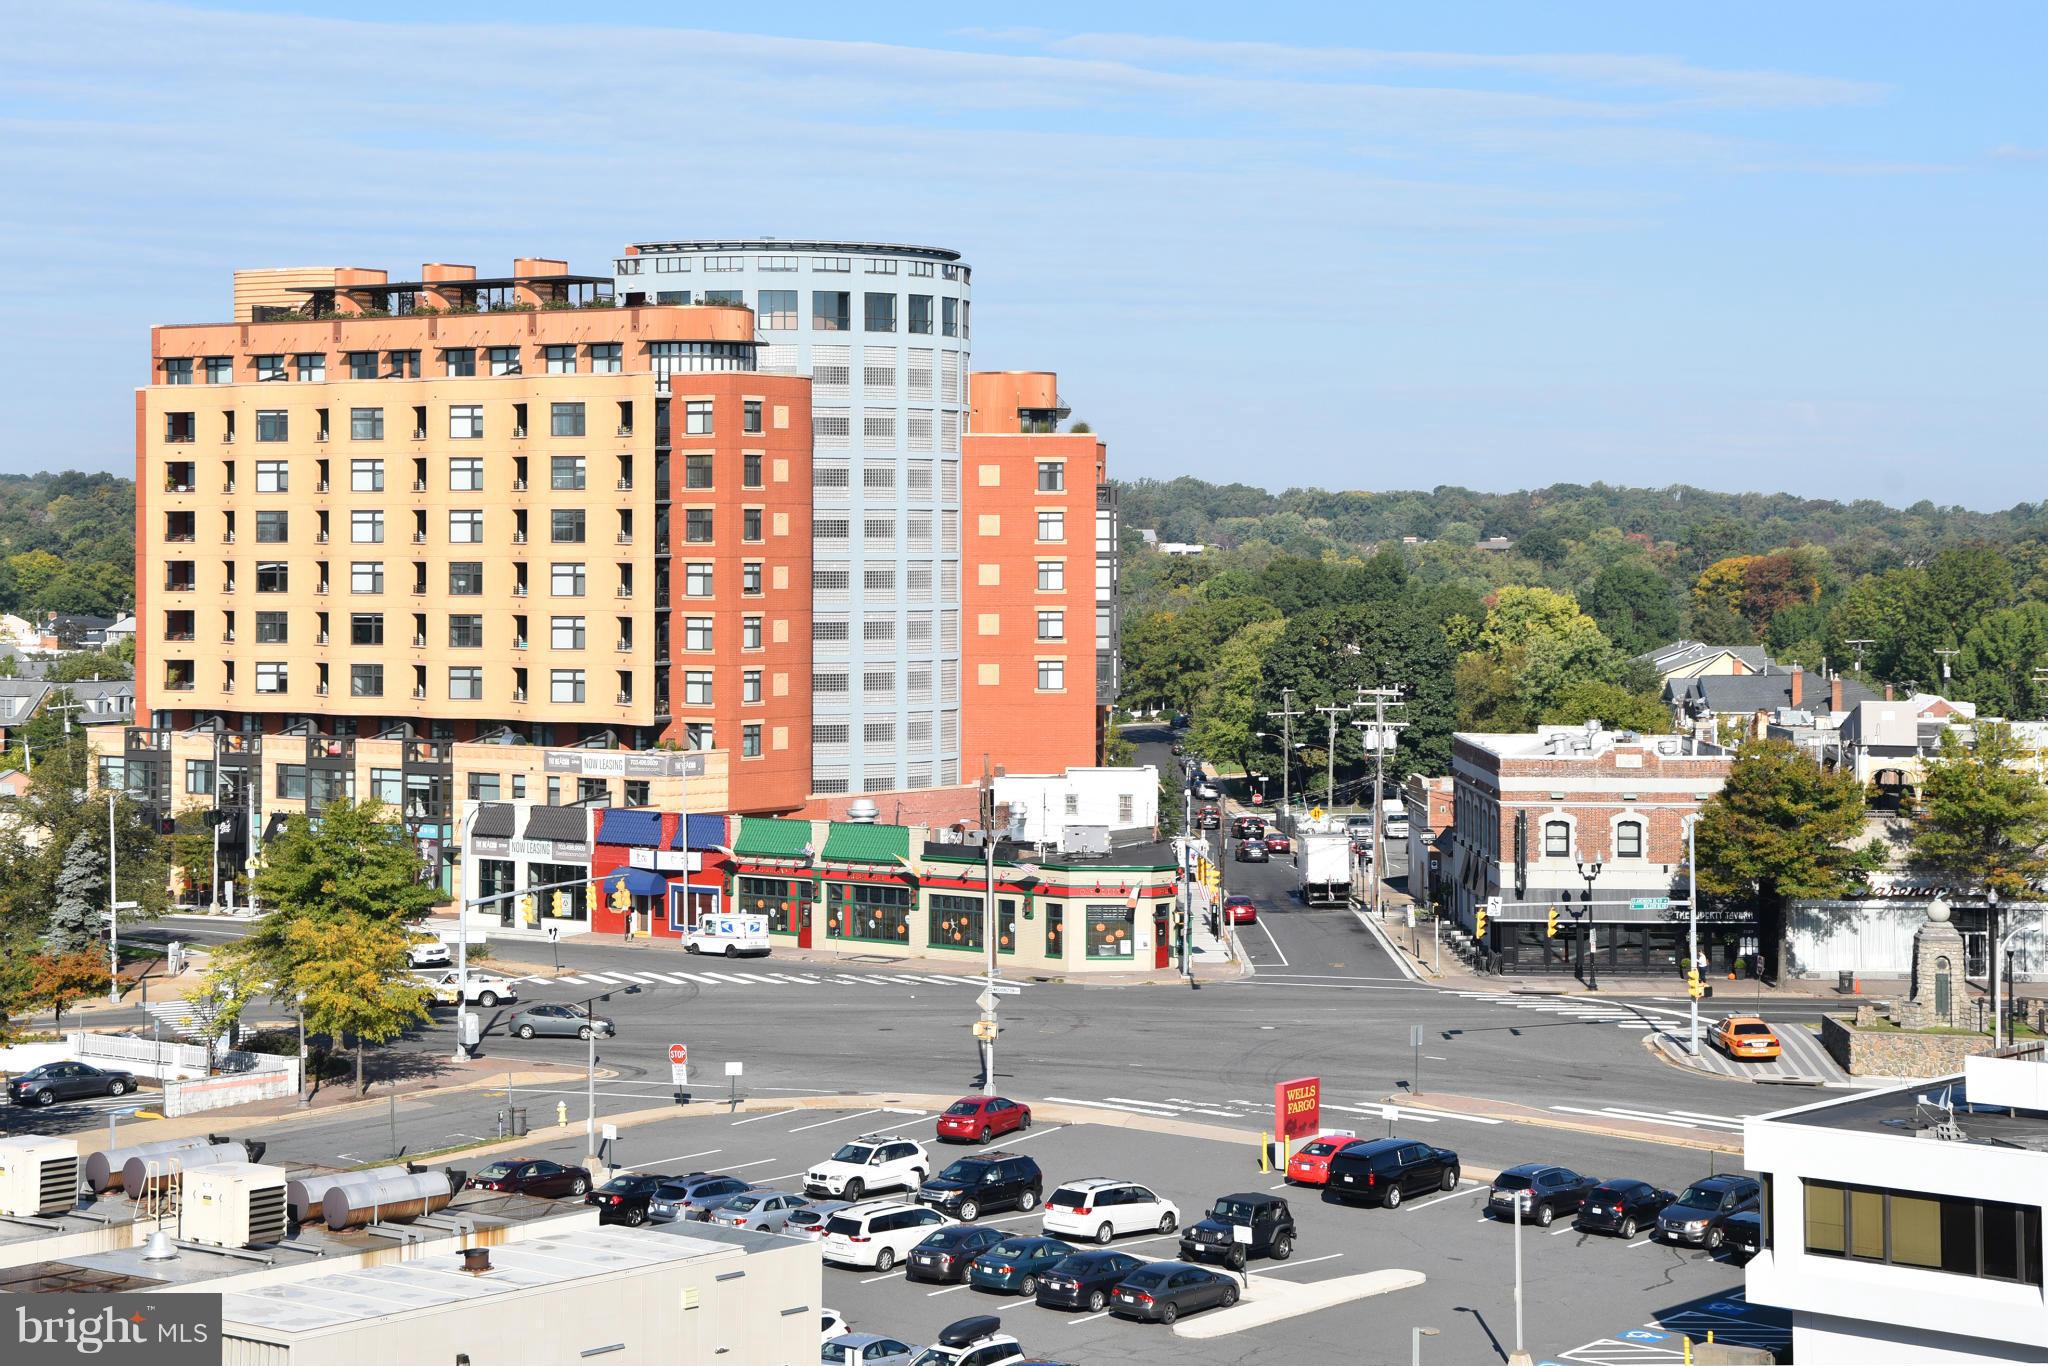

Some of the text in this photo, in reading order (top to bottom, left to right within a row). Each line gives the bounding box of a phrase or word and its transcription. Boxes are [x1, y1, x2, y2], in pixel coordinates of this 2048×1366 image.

[584, 758, 599, 769] NOW
[599, 759, 624, 771] LEASING
[511, 841, 526, 853] NOW
[526, 842, 551, 855] LEASING
[1674, 911, 1690, 920] THE
[1724, 911, 1754, 920] TAVERN
[670, 1050, 686, 1059] STOP
[1286, 1085, 1316, 1102] WELLS
[1287, 1098, 1316, 1115] FARGO
